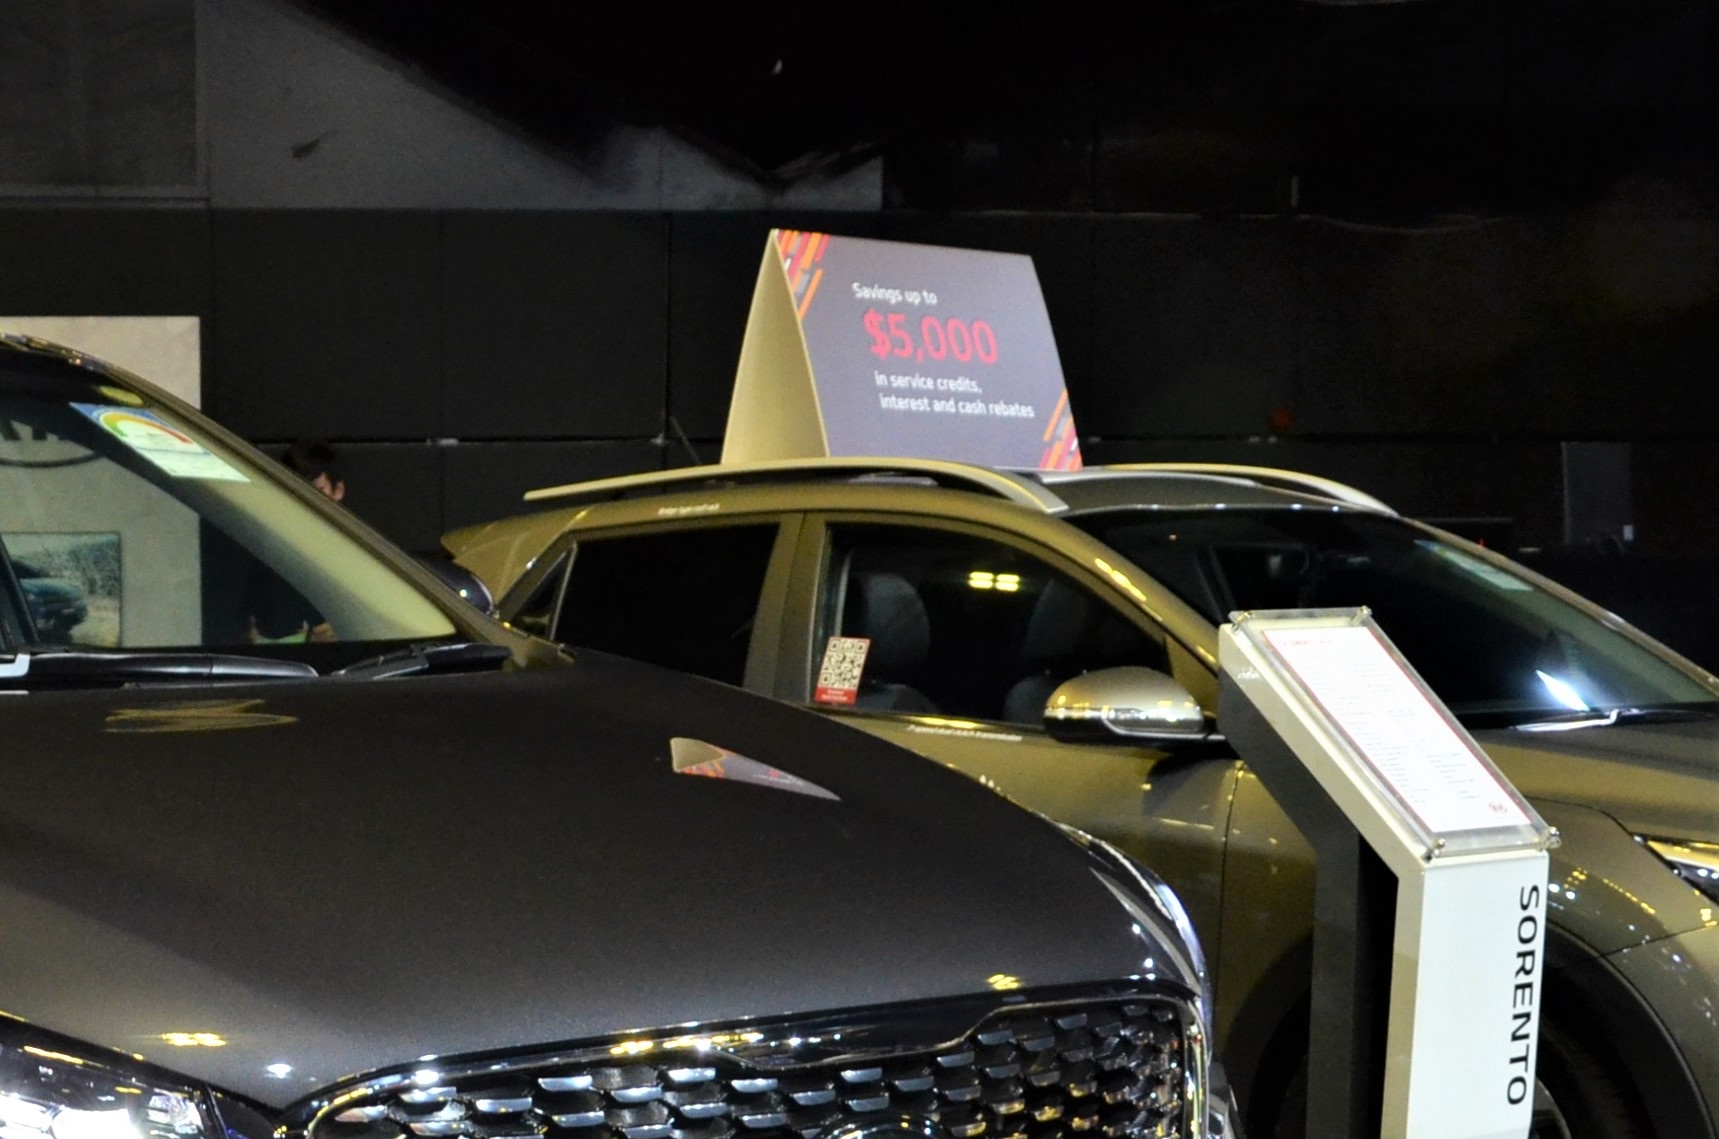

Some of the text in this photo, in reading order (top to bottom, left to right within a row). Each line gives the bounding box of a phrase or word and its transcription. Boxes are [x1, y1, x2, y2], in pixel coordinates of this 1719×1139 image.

[852, 282, 937, 305] Savings up to
[863, 307, 998, 365] $5,000
[874, 370, 982, 393] in service credits,
[880, 393, 1035, 418] interest and cash rebates
[1506, 884, 1540, 1106] SORENTO
